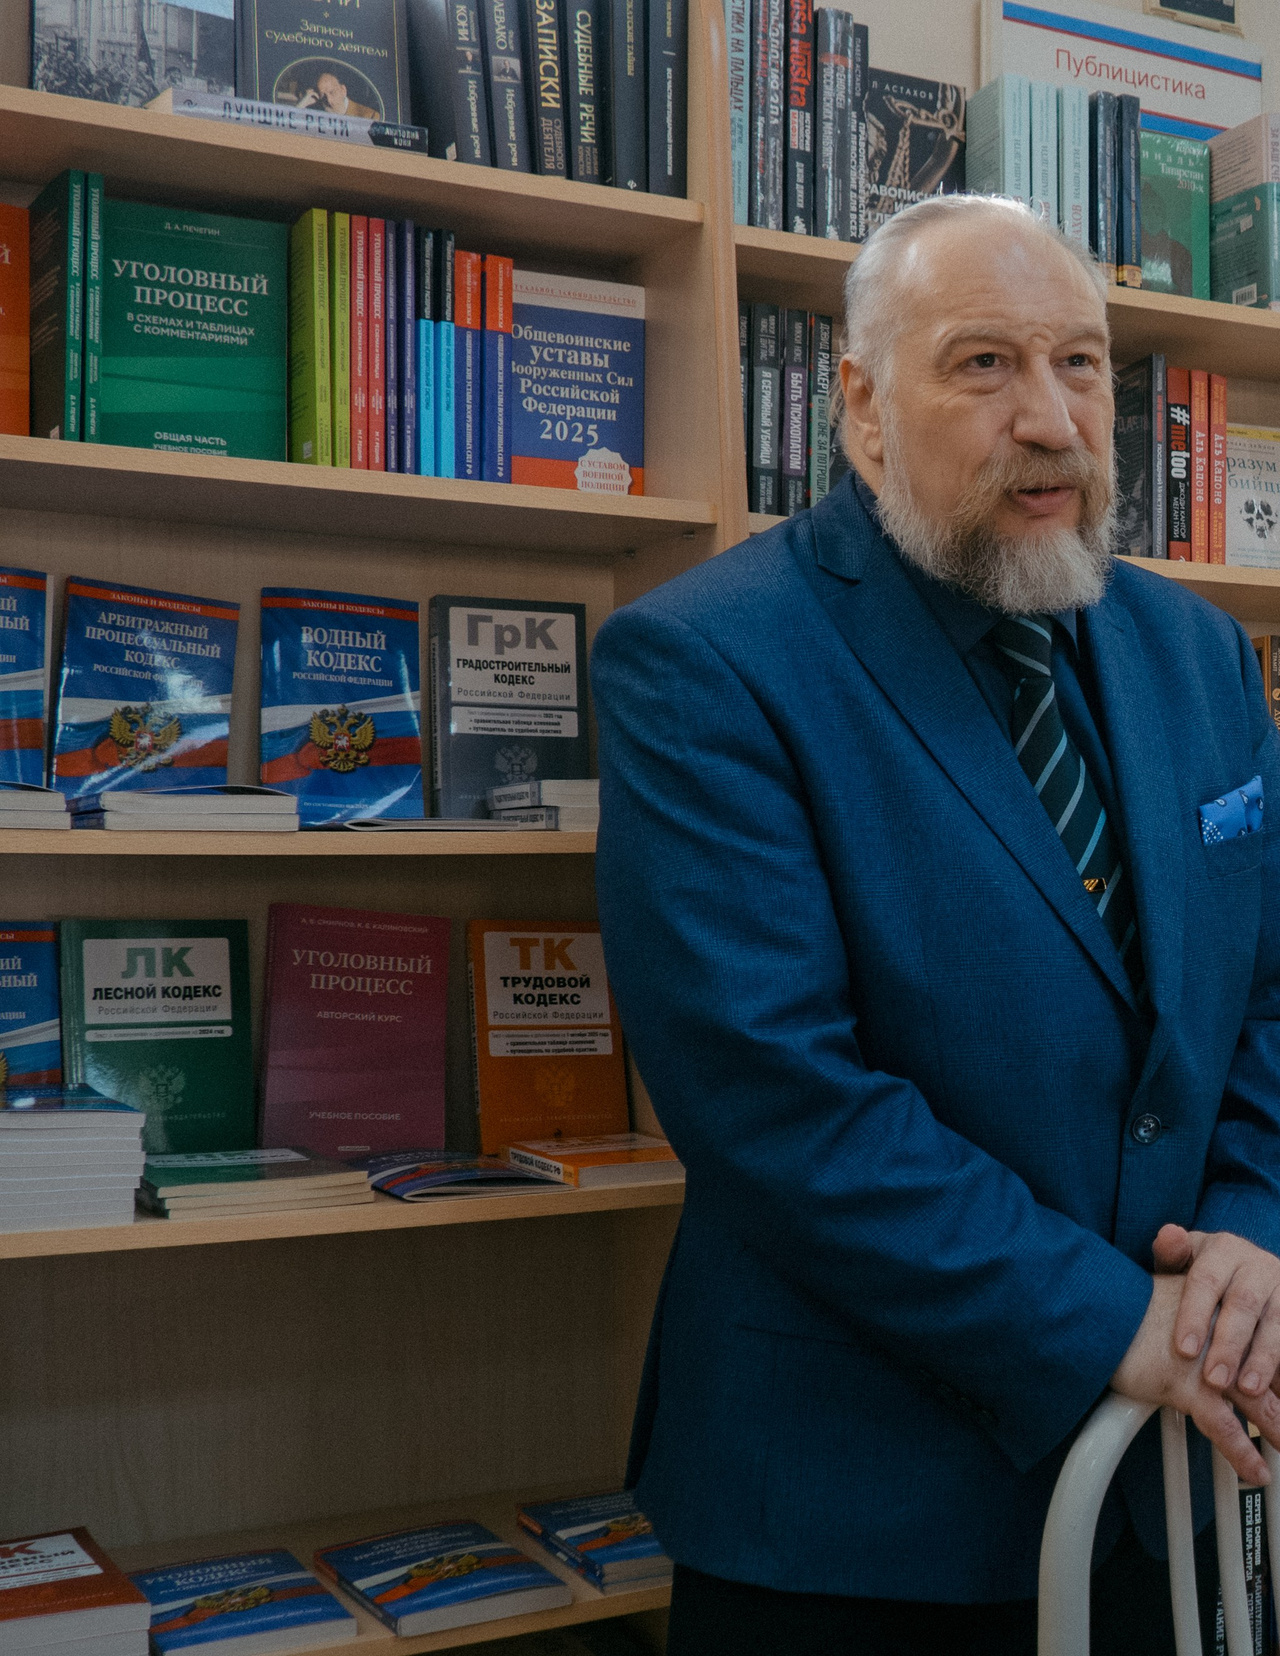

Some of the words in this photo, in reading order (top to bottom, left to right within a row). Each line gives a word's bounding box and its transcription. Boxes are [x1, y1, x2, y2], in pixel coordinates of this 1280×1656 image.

[300, 19, 354, 39] Записки
[455, 4, 471, 42] КОНИ
[265, 30, 334, 48] судебного
[337, 41, 389, 58] деятеля
[535, 0, 562, 109] ЗАПИСКИ
[575, 9, 595, 97] СУДЕБНЫЕ
[1056, 49, 1207, 101] Публицистика
[222, 101, 297, 130] ЛУЧШИЕ
[305, 114, 350, 137] РЕЧИ
[580, 103, 596, 144] РЕЧИ
[112, 258, 269, 296] УГОЛОВНЫЙ
[134, 285, 249, 317] ПРОЦЕСС
[127, 313, 134, 322] В
[137, 315, 183, 327] СХЕМАХ
[186, 320, 194, 329] И
[197, 322, 255, 337] ТАБЛИЦАХ
[134, 324, 142, 333] С
[145, 327, 249, 346] КОММЕНТАРИЯМИ
[511, 323, 631, 352] Общевоинские
[819, 322, 829, 350] ДЭВИД
[530, 344, 610, 369] уставы
[606, 371, 634, 387] Сил
[816, 351, 830, 396] РАЙХЕРТ
[519, 378, 620, 405] Российской
[790, 371, 803, 402] БЫТЬ
[522, 396, 617, 421] Федерации
[154, 431, 191, 444] ОБЩАЯ
[194, 436, 228, 447] ЧАСТЬ
[540, 419, 599, 447] 2025
[789, 402, 803, 471] ПСИХОПАТОМ
[1170, 405, 1191, 480] #metoo
[1195, 431, 1206, 453] Аль
[1213, 432, 1224, 455] Аль
[582, 470, 624, 482] ВОЕННОЙ
[1227, 456, 1277, 476] разум
[581, 480, 625, 493] ПОЛИЦИИ
[1195, 456, 1206, 503] Капоне
[1213, 458, 1225, 505] Капоне
[97, 611, 209, 640] АРБИТРАЖНЫЙ
[301, 625, 387, 651] ВОДНЫЙ
[466, 613, 558, 656] ГрК
[85, 625, 221, 659] ПРОЦЕССУАЛЬНЫЙ
[93, 663, 152, 681] РОССИЙСКОЙ
[124, 650, 182, 670] КОДЕКС
[306, 650, 382, 674] КОДЕКС
[456, 658, 571, 674] ГРАДОСТРОИТЕЛЬНЫЙ
[292, 672, 346, 684] РОССИЙСКОЙ
[347, 675, 394, 687] ФЕДЕРАЦИИ
[493, 673, 536, 686] КОДЕКС
[457, 687, 514, 699] Российской
[518, 691, 571, 701] Федерации
[120, 946, 195, 980] ЛК
[292, 948, 433, 975] УГОЛОВНЫЙ
[509, 937, 579, 971] ТК
[92, 983, 157, 1001] ЛЕСНОЙ
[161, 985, 222, 1001] КОДЕКС
[310, 974, 414, 997] ПРОЦЕСС
[500, 974, 591, 991] ТРУДОВОЙ
[98, 1005, 158, 1016] Российской
[162, 1003, 218, 1015] Федерации
[513, 993, 582, 1007] КОДЕКС
[316, 1011, 376, 1022] АВТОРСКИЙ
[378, 1014, 403, 1024] КУРС
[492, 1010, 549, 1021] Российской
[552, 1010, 605, 1021] Федерации
[308, 1110, 353, 1121] УЧЕБНОЕ
[355, 1111, 402, 1122] ПОСОБИЕ
